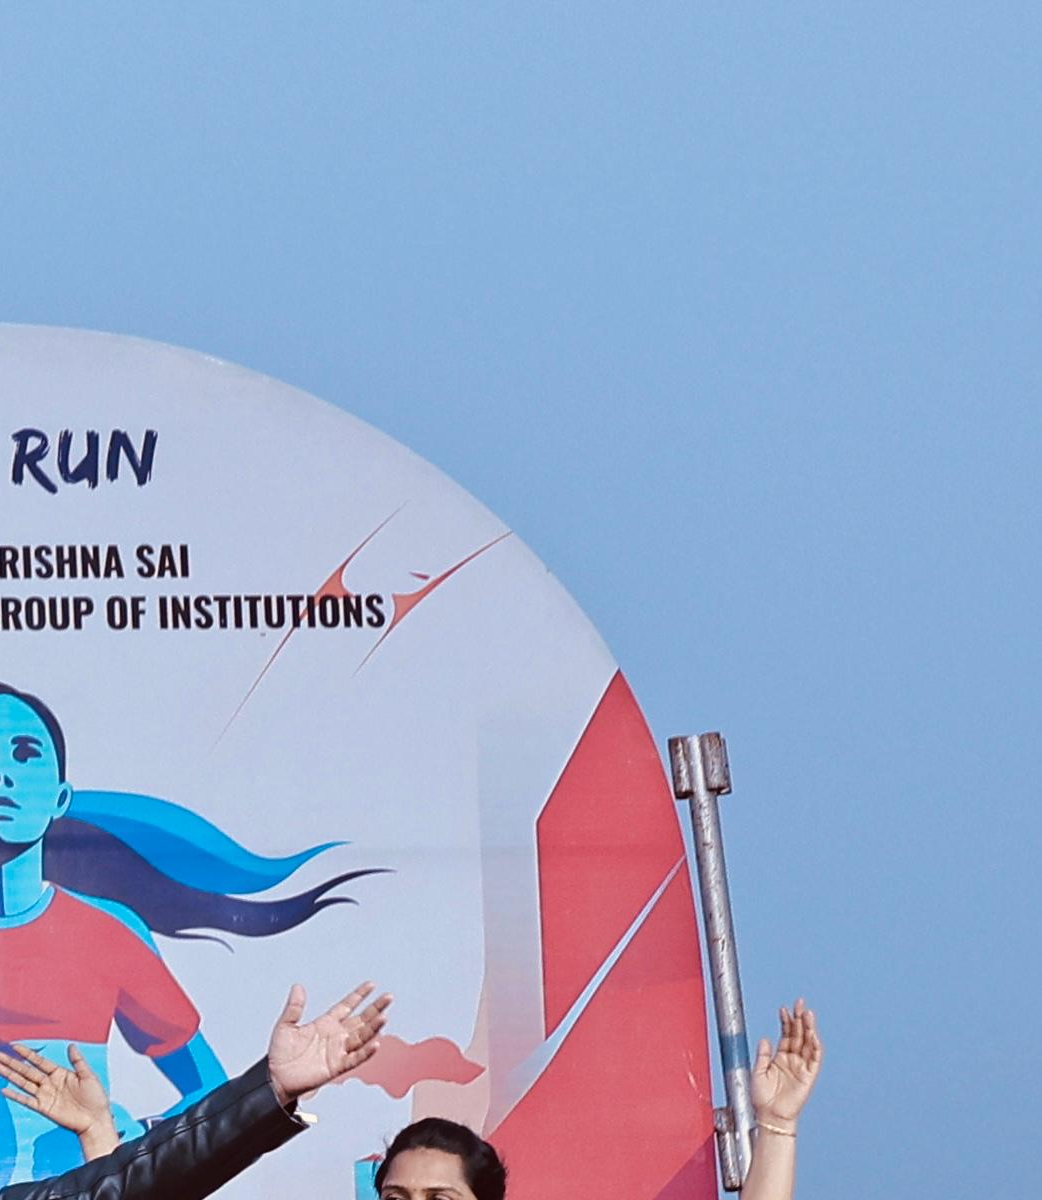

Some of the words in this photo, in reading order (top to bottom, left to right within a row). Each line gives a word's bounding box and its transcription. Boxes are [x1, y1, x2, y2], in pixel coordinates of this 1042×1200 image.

[11, 428, 158, 494] RUN
[136, 543, 190, 578] SAI
[106, 596, 146, 631] OF
[158, 594, 386, 629] INSTITUTIONS
